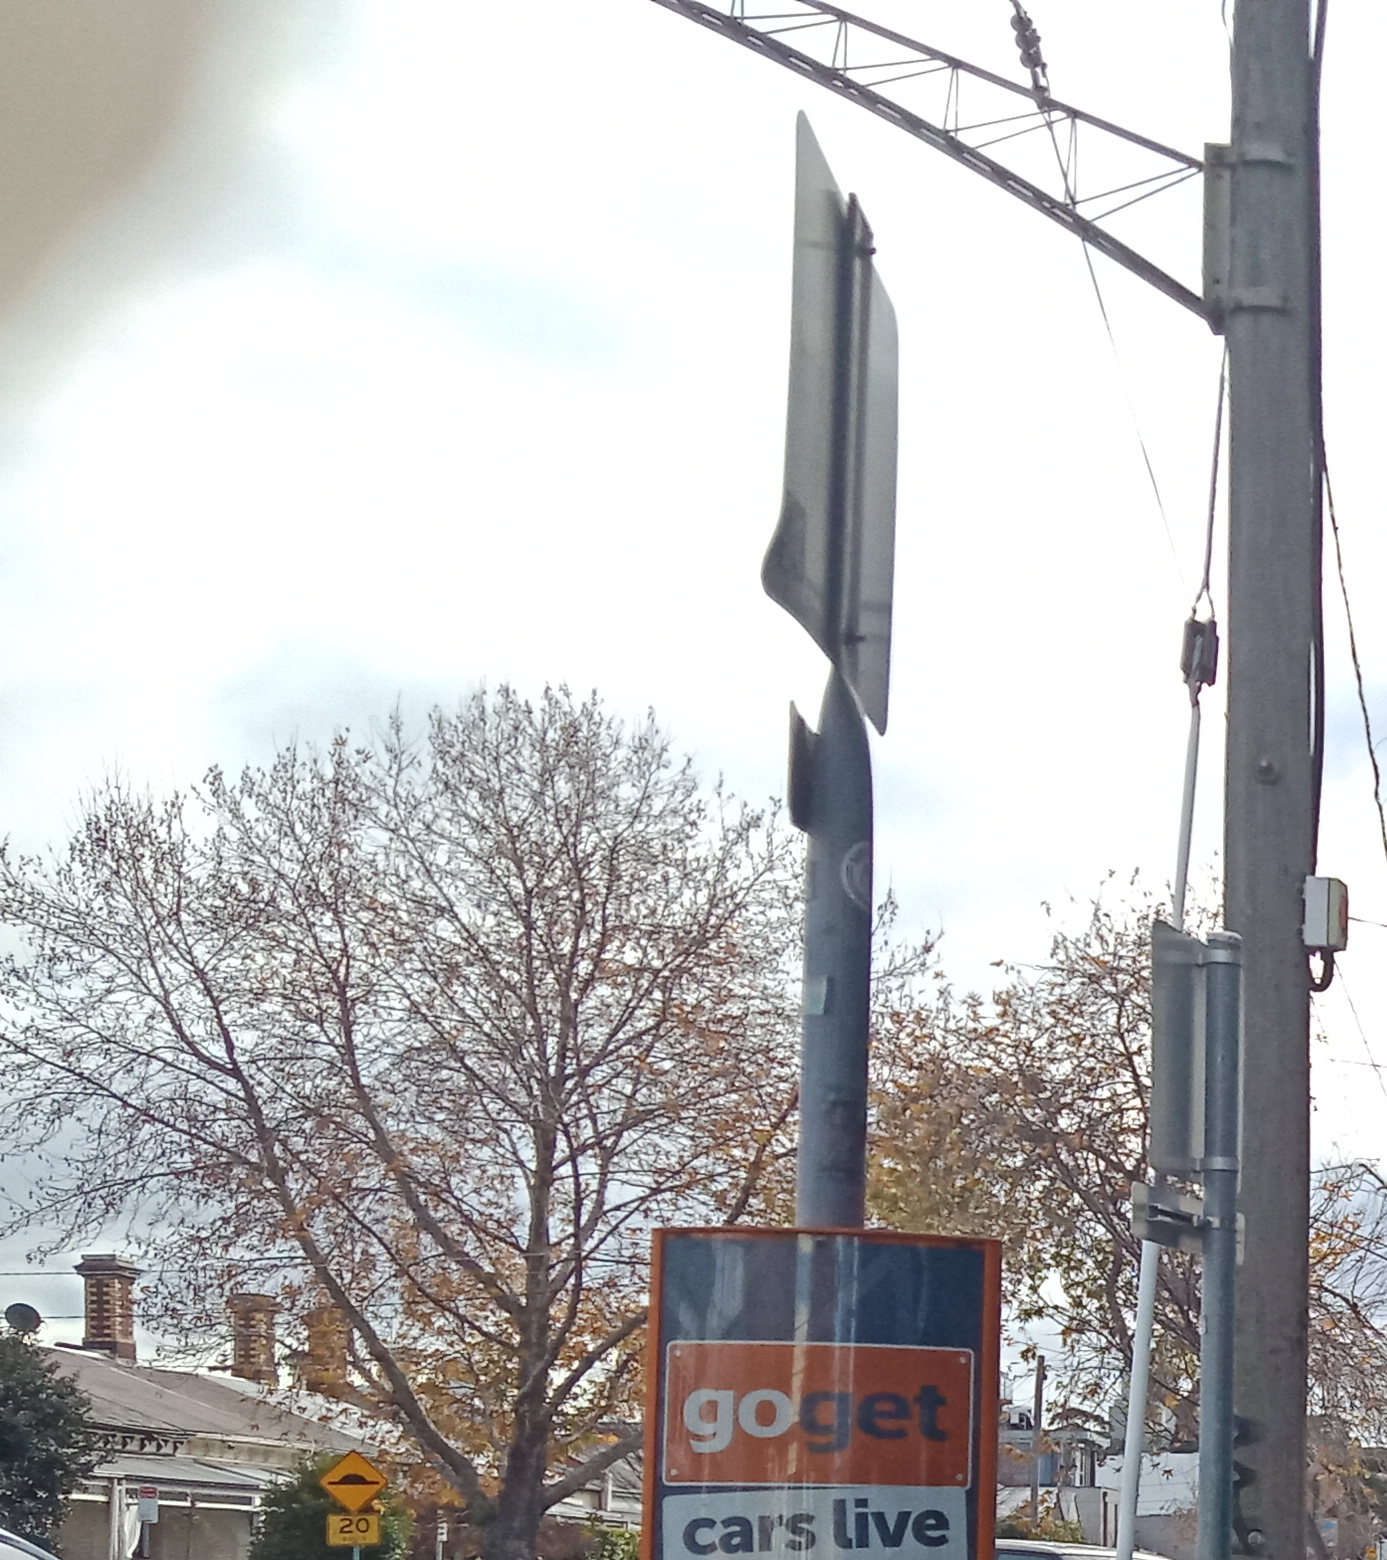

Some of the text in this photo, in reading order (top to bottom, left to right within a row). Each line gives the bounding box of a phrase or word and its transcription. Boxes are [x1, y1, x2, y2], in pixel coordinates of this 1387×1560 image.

[683, 1384, 949, 1454] goget
[339, 1517, 370, 1534] 20
[682, 1498, 950, 1555] cars live
